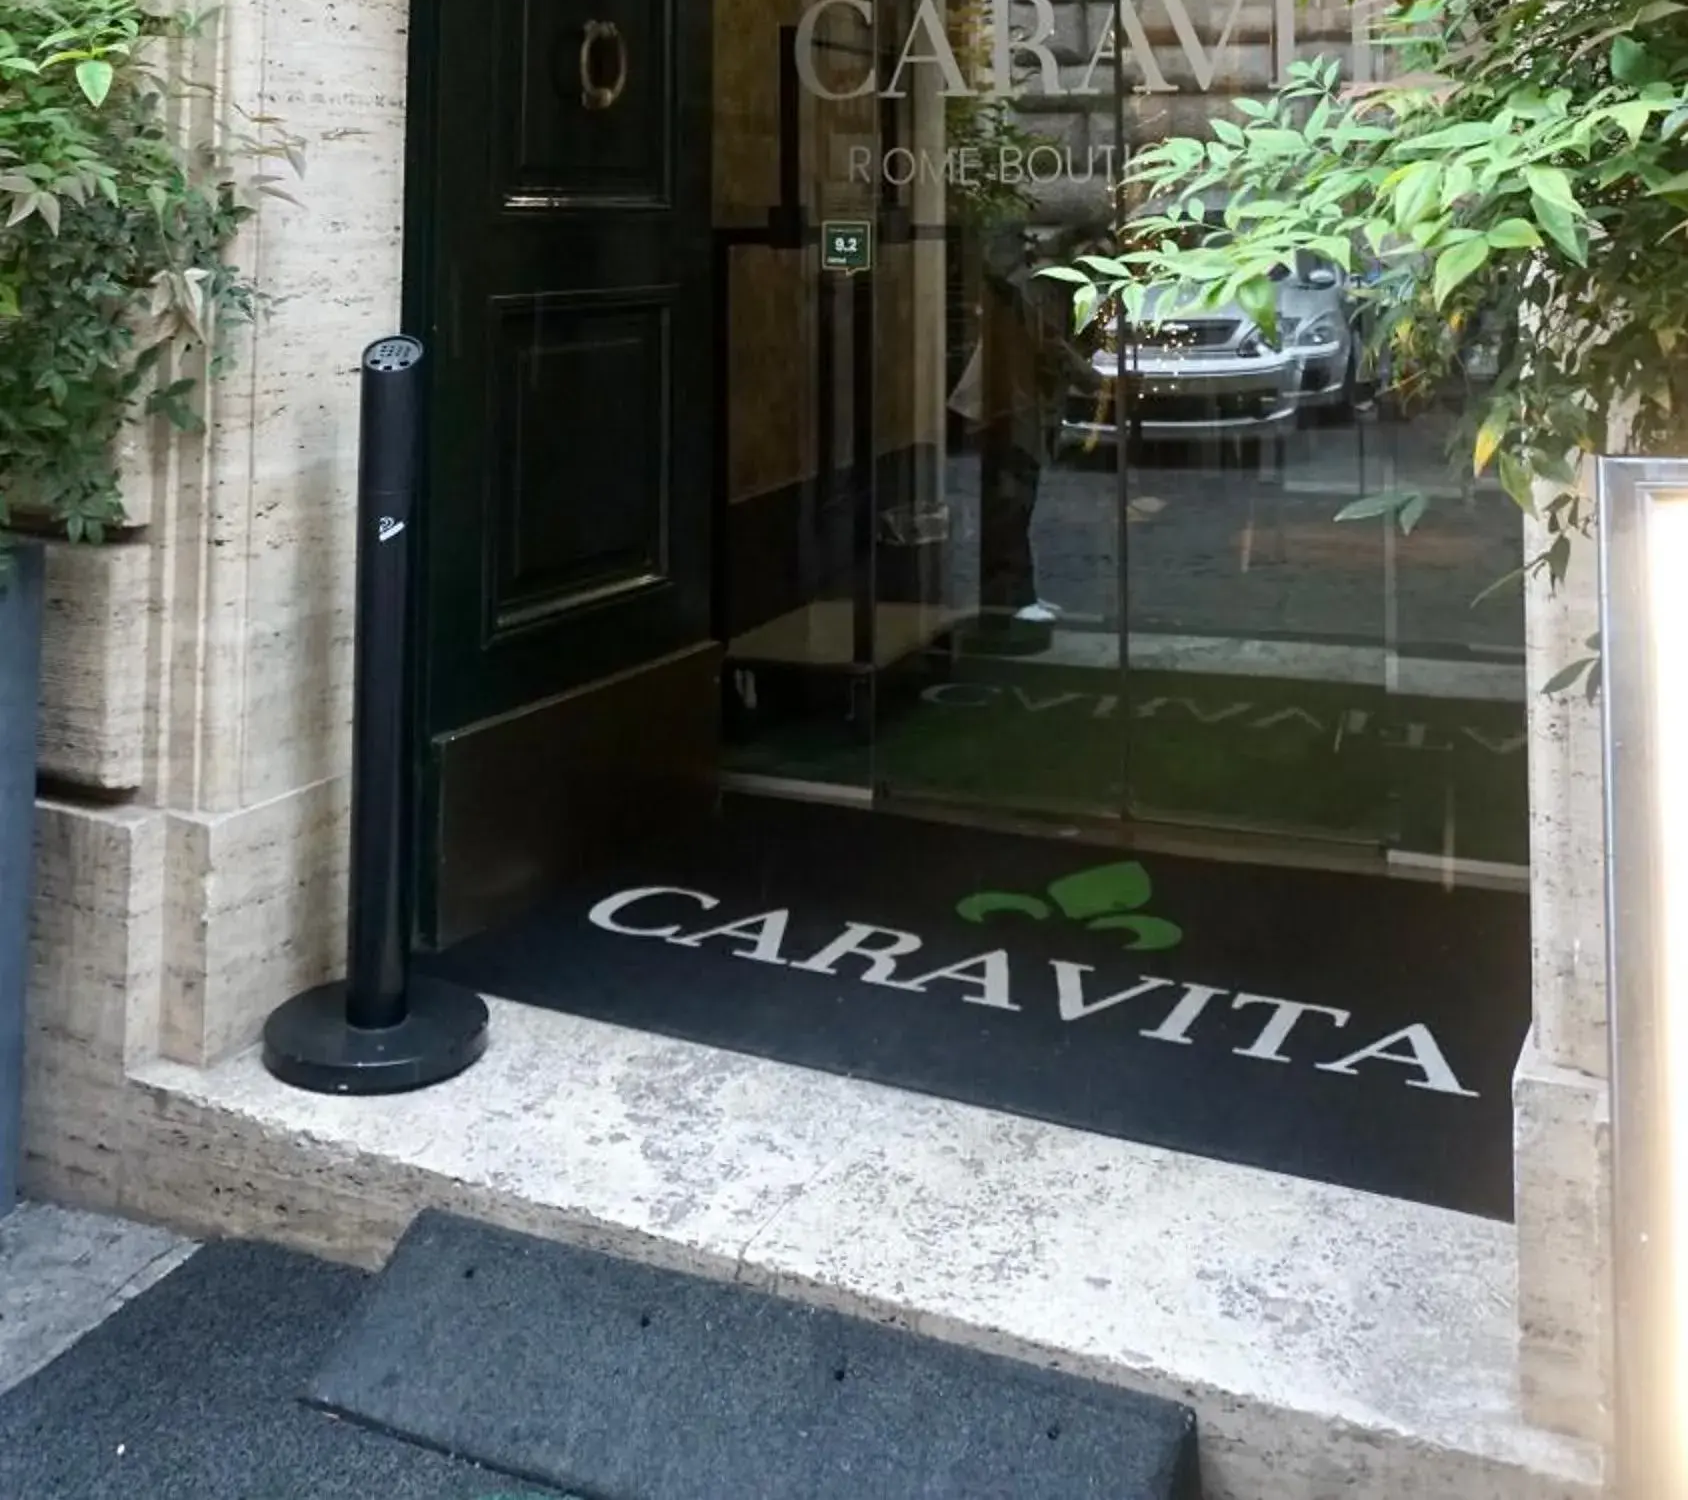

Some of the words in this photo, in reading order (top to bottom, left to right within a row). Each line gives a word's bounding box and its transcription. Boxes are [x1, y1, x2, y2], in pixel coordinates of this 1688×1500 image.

[850, 146, 981, 186] ROME
[1000, 142, 1161, 185] BOUTI
[834, 237, 858, 253] 9.2
[588, 886, 1480, 1097] CARAVITA
